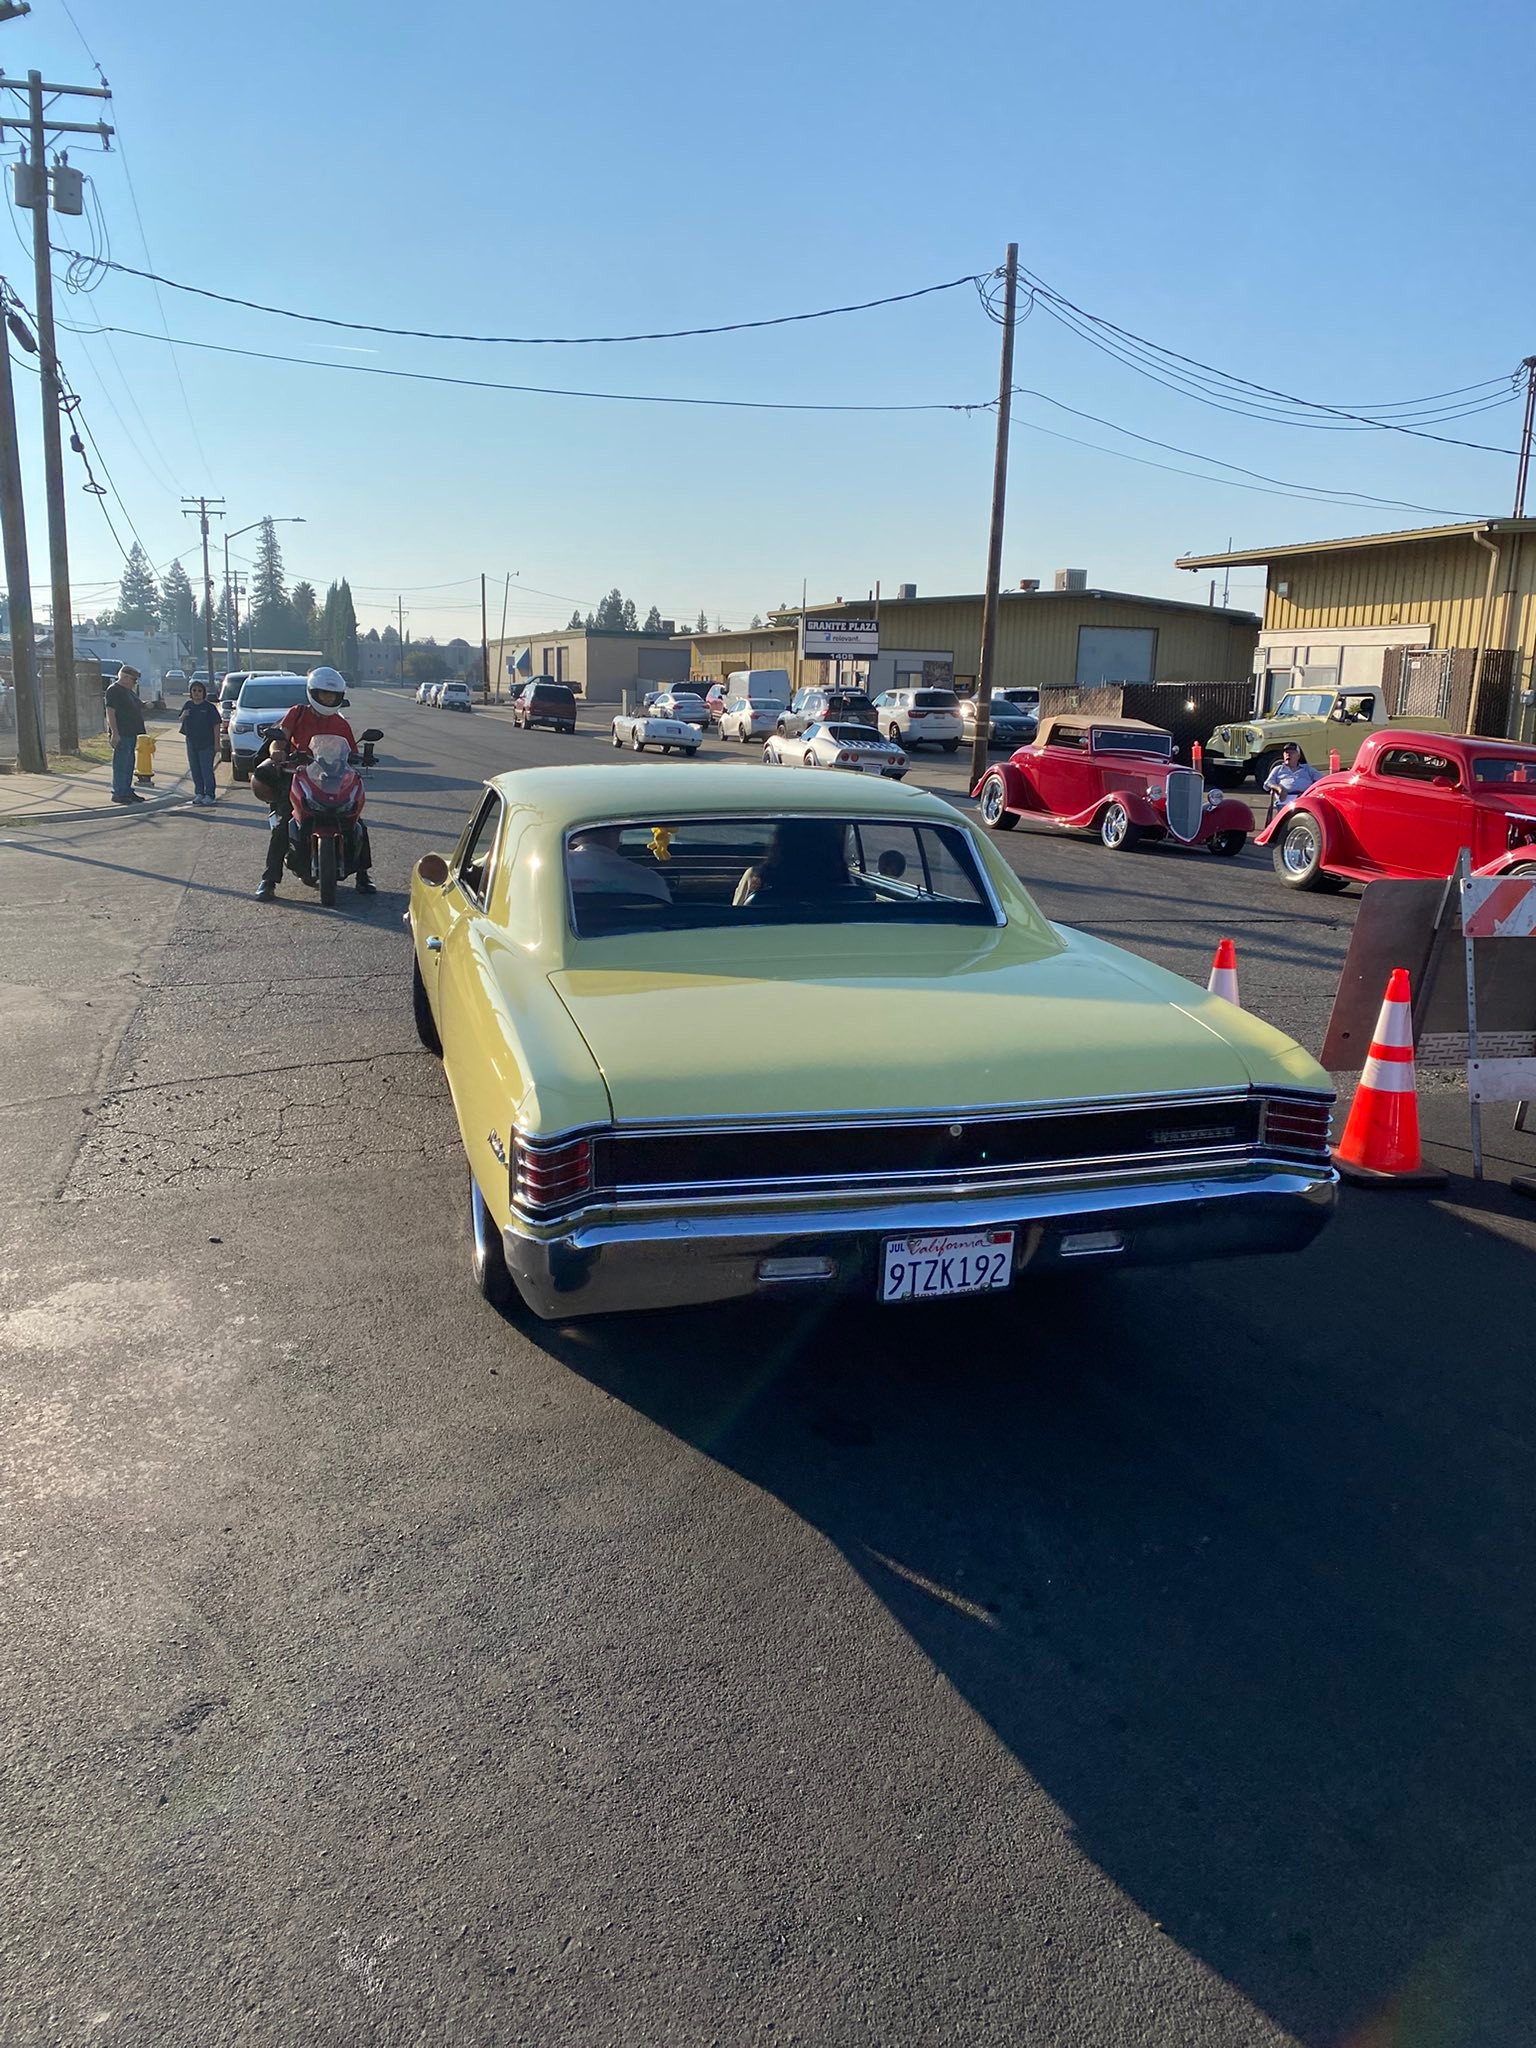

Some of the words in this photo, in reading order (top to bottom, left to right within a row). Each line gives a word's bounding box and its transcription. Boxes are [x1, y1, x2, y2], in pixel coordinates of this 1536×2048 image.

[808, 621, 847, 631] GRANITE
[848, 622, 878, 632] PLAZA
[889, 1243, 905, 1253] JUL
[909, 1235, 990, 1257] California
[887, 1253, 1006, 1296] 9TZK192
